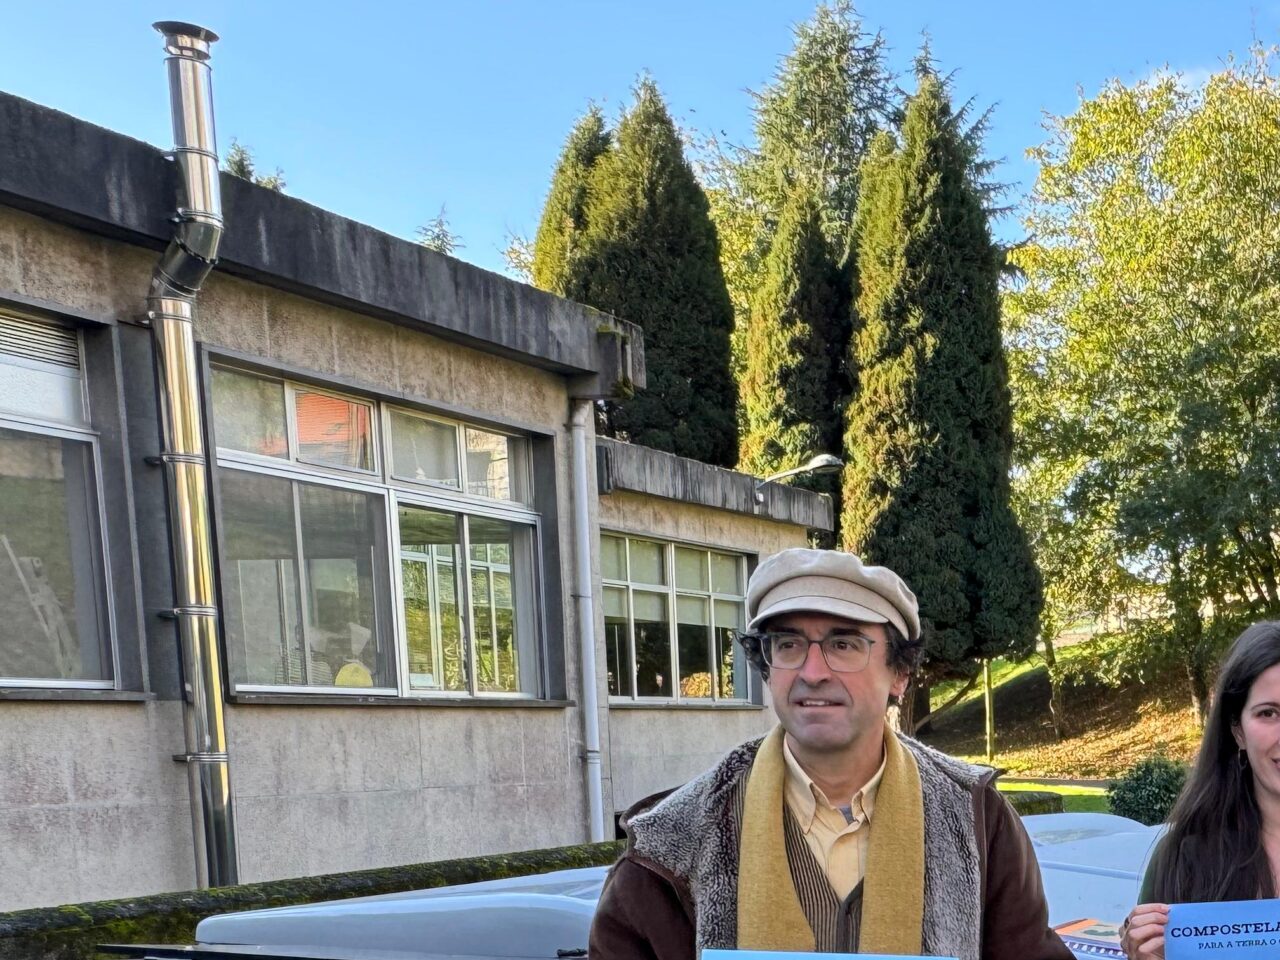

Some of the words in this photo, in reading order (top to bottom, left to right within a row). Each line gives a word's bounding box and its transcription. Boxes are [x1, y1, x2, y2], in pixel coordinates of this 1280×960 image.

[1198, 941, 1224, 950] PARA
[1226, 940, 1234, 948] A
[1237, 939, 1268, 947] TERRA
[1270, 938, 1277, 946] O
